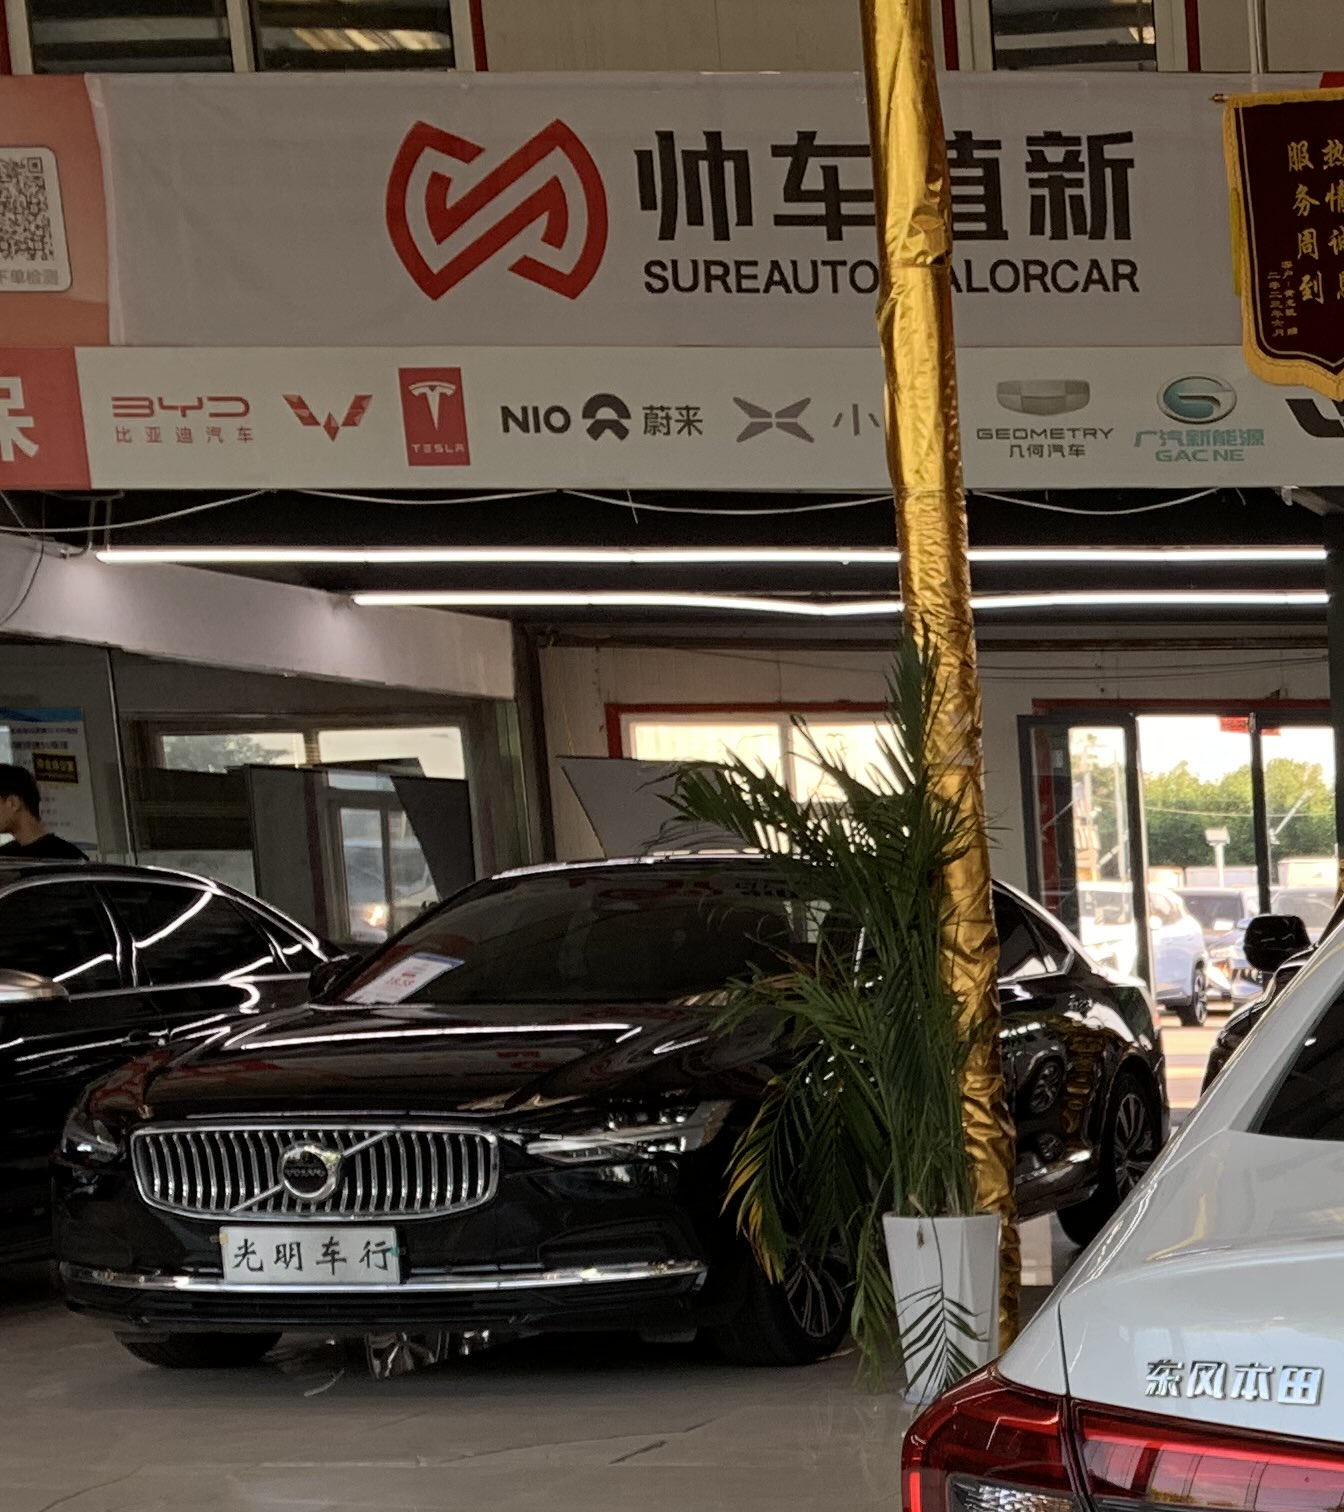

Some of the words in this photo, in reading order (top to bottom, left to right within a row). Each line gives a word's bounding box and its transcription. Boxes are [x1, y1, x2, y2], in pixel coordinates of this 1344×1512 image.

[1288, 140, 1325, 304] 服务周到
[643, 259, 880, 294] SUREAUTO
[112, 396, 250, 418] BYD
[501, 405, 572, 434] NIO
[643, 405, 704, 437] 蔚来
[115, 425, 254, 444] 比亚迪汽车
[976, 427, 1114, 441] GEOMETRY
[1134, 428, 1265, 448] 广汽新能源
[411, 443, 465, 454] TESLA
[1009, 443, 1086, 459] 几何汽车
[232, 1236, 395, 1276] 光明车行
[1145, 1360, 1324, 1405] 东风本田
